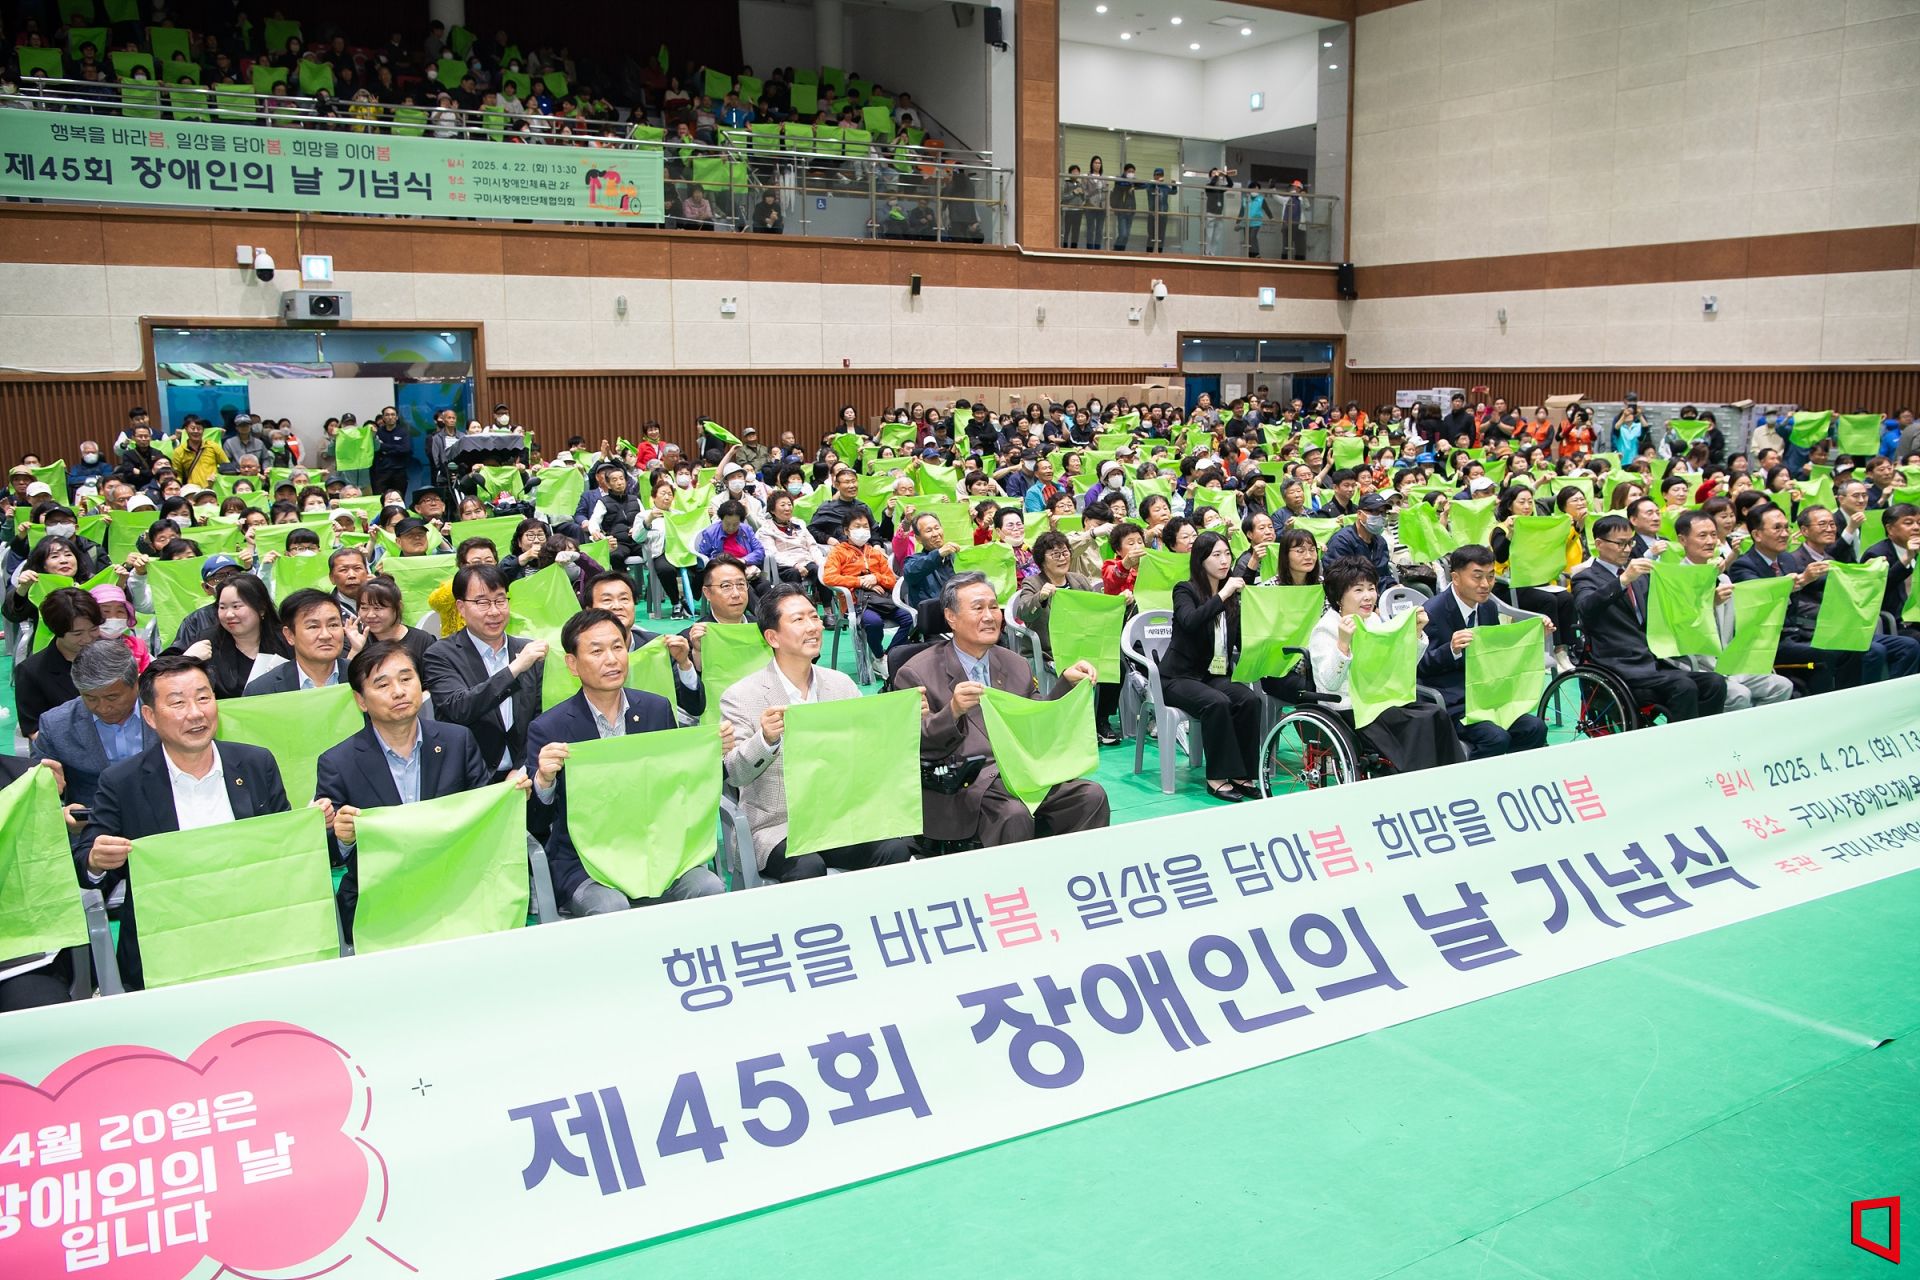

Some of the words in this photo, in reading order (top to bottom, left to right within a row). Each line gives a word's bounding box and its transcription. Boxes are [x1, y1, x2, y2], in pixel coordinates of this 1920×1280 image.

[51, 123, 105, 144] 행복을
[112, 128, 170, 149] 바라봄,
[177, 132, 226, 152] 일상을
[233, 136, 287, 156] 담아봄,
[292, 140, 339, 159] 희망을
[345, 144, 391, 161] 이어봄
[4, 152, 113, 185] 제45회
[131, 156, 274, 194] 장애인의
[291, 165, 323, 195] 날
[337, 168, 432, 201] 기념식
[472, 161, 498, 170] 2025.
[502, 162, 510, 170] 4.
[514, 163, 529, 172] 22.
[532, 164, 548, 174] (화)
[552, 165, 577, 174] 13:30
[473, 176, 556, 190] 구미시장애인체육관
[560, 181, 570, 190] 2F
[473, 193, 576, 206] 구미시장애인단체협의회
[1716, 768, 1755, 797] 일시
[1763, 756, 1818, 787] 2025.
[1820, 752, 1839, 774] 4.
[1838, 744, 1870, 769] 22.
[1867, 735, 1902, 763] (화)
[1742, 815, 1786, 840] 장소
[1774, 855, 1824, 875] 주관
[662, 922, 858, 1013] 행복을
[871, 886, 1061, 969] 바라봄,
[1066, 852, 1218, 931] 일상을
[1220, 823, 1373, 898] 담아봄,
[1371, 797, 1497, 862] 희망을
[1496, 774, 1608, 835] 이어봄
[508, 1023, 933, 1197] 제45회
[956, 906, 1409, 1090] 장애인의
[1404, 881, 1523, 972] 날
[1510, 824, 1762, 935] 기념식
[0, 1121, 84, 1169] 4월
[99, 1090, 259, 1152] 20일은
[236, 1131, 296, 1185] 날
[61, 1199, 213, 1273] 입니다
